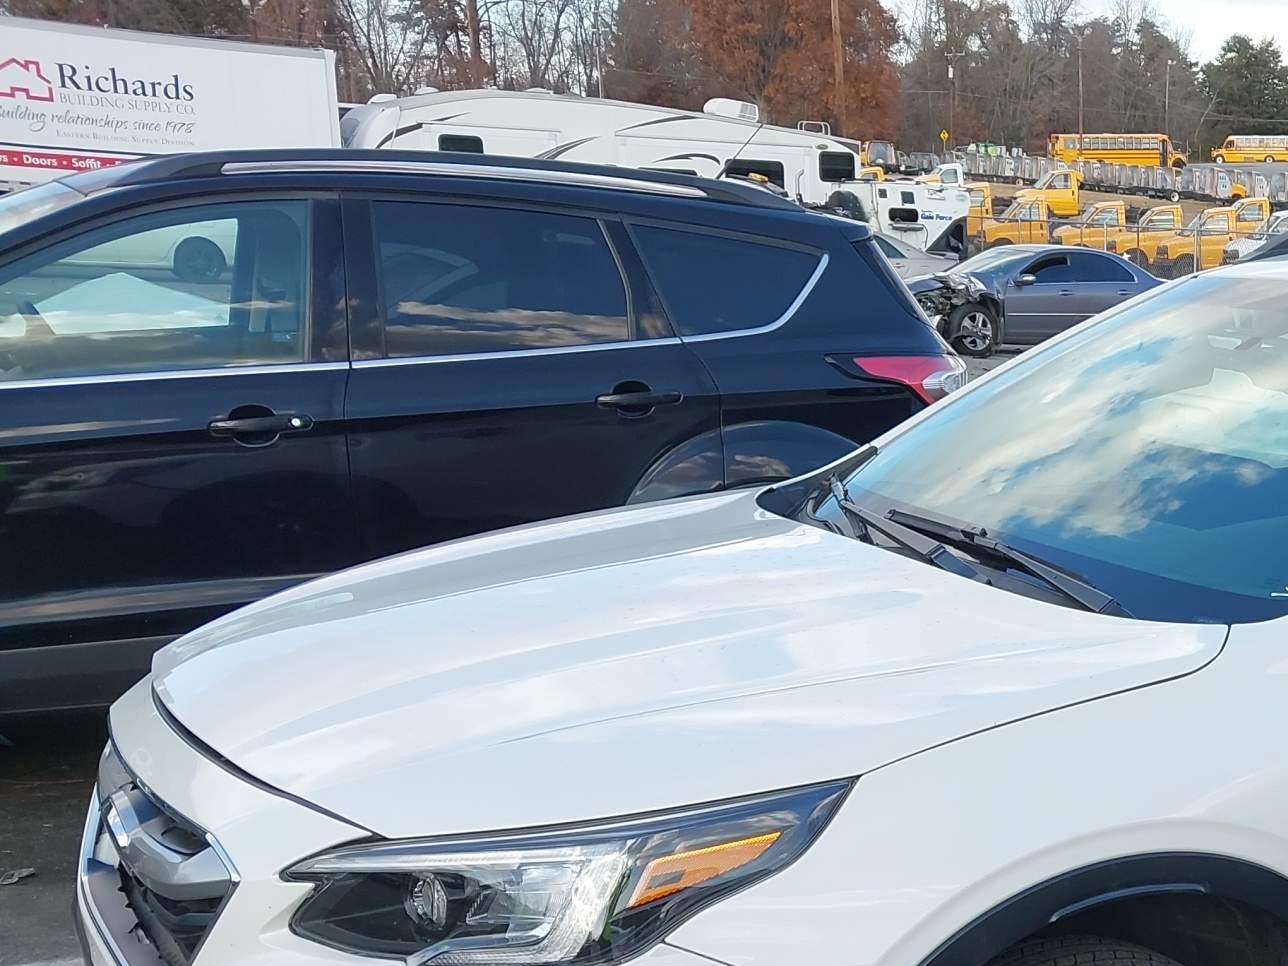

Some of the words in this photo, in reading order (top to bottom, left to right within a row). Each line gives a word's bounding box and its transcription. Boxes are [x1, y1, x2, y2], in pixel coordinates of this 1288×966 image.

[55, 62, 195, 101] Richards
[59, 93, 125, 109] BUILDING
[128, 102, 173, 113] SUPPLY
[176, 105, 196, 115] CO.
[51, 110, 128, 132] relationships
[133, 119, 161, 131] since
[165, 121, 196, 134] 1978
[23, 153, 57, 166] Doors
[72, 158, 101, 169] Soffit
